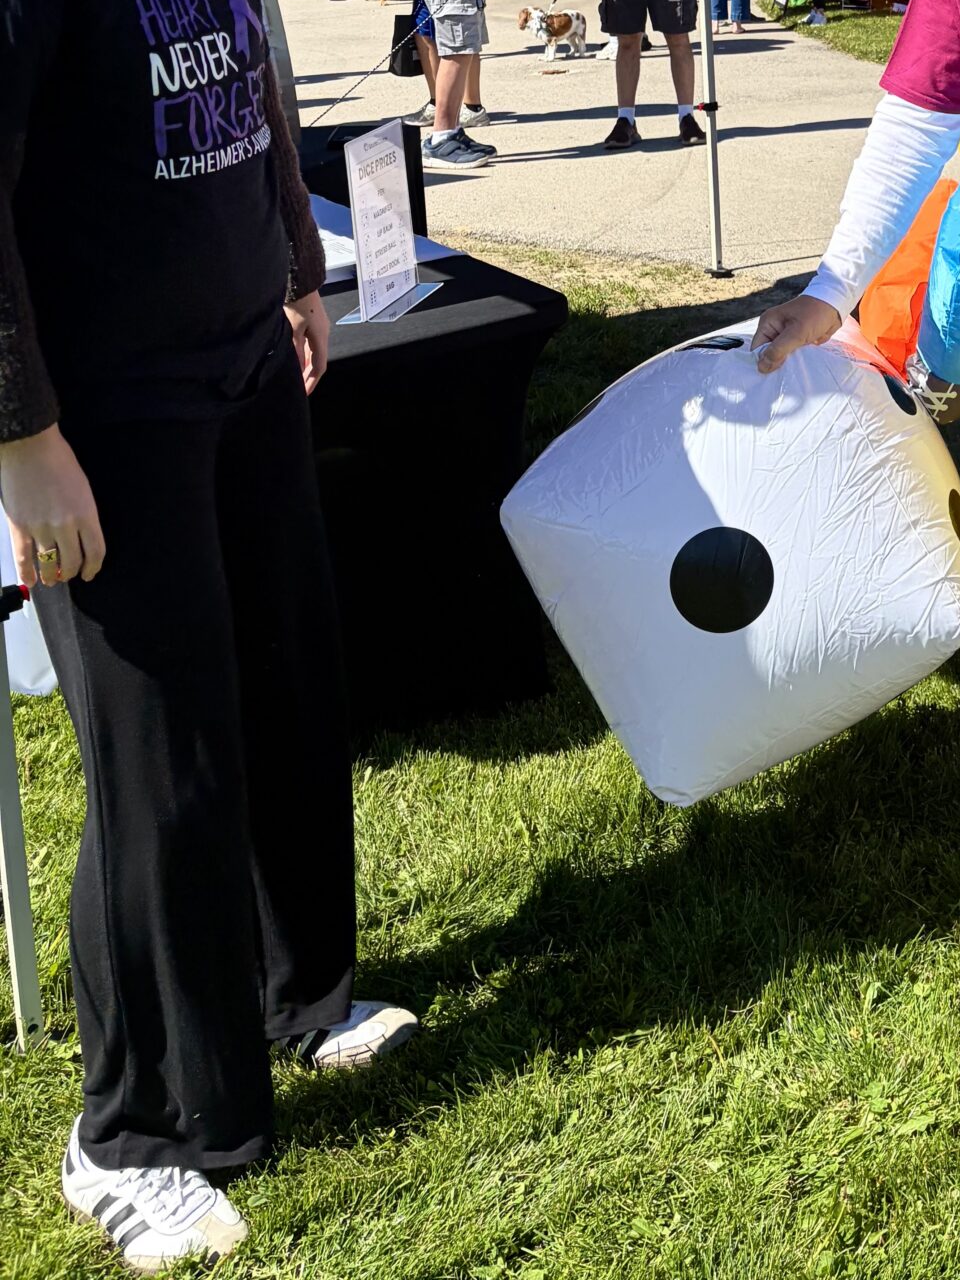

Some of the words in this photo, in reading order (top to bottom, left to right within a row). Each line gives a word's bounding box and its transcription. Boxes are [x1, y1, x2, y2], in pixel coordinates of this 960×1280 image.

[149, 31, 238, 96] NEVER
[154, 137, 253, 180] ALZHEIMER'S
[358, 161, 375, 181] DICE
[375, 150, 397, 172] PRIZES
